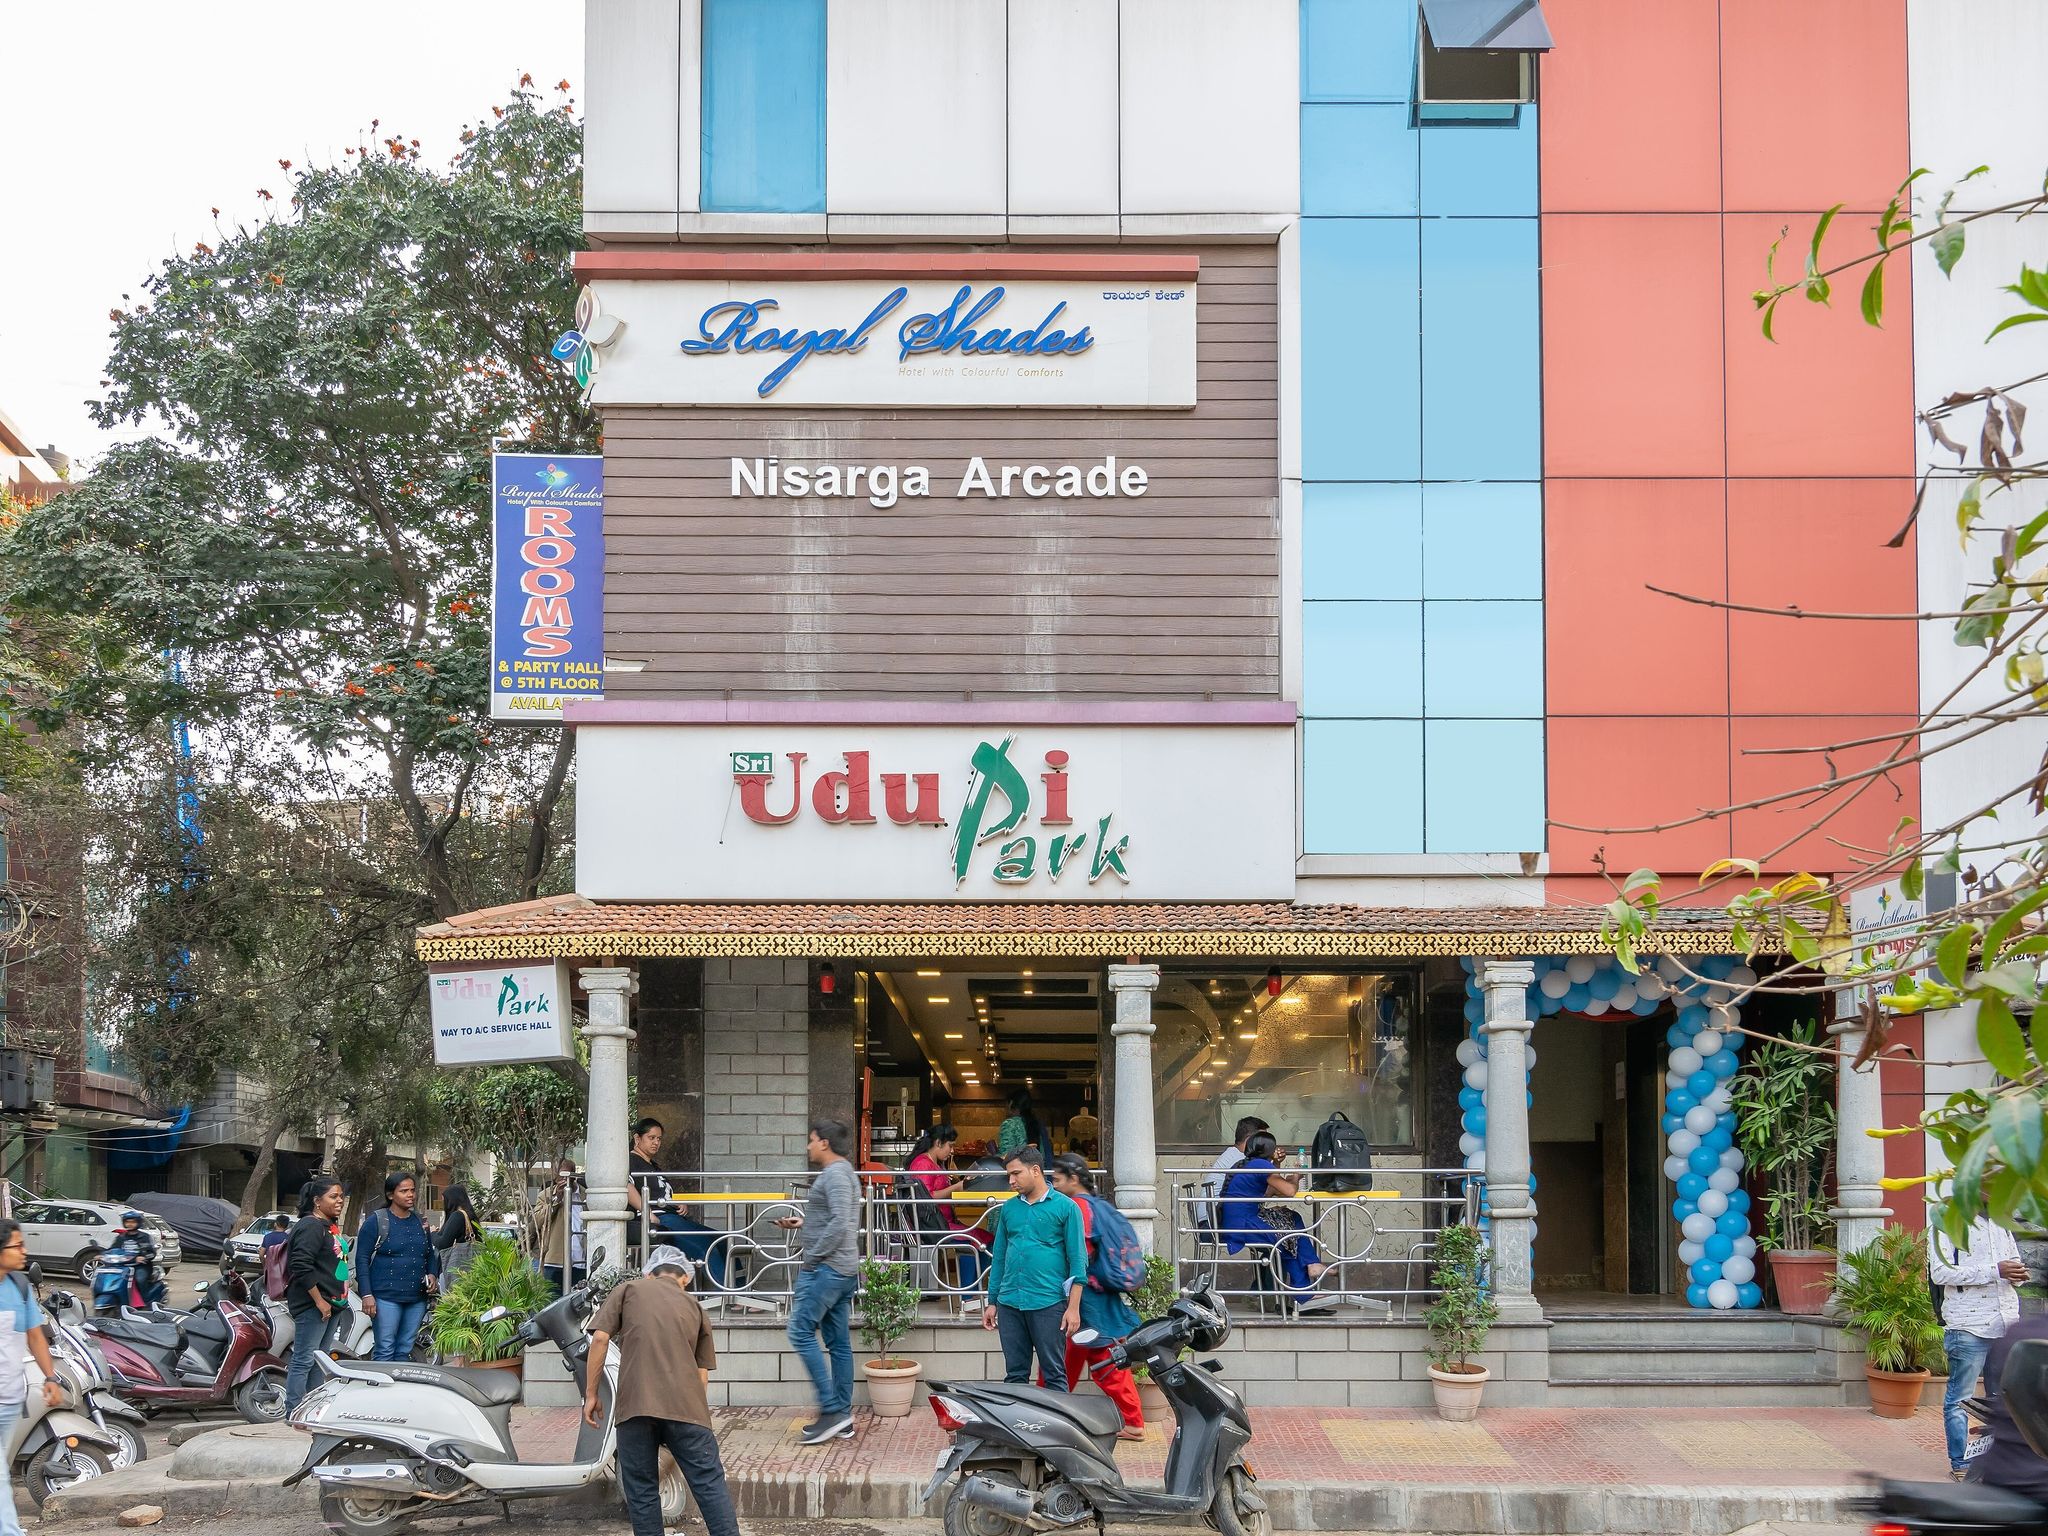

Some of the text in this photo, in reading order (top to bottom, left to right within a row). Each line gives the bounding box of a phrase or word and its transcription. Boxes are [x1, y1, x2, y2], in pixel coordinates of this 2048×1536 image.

[680, 284, 1095, 398] Royal Shades
[899, 367, 1064, 377] Hotel with Colourful Comforts
[731, 455, 1149, 508] Nisarga Arcade
[500, 483, 604, 506] Royal Shades
[520, 507, 577, 658] ROOMS
[498, 661, 603, 675] & PARTY HALL
[501, 676, 600, 690] @ 5TH FLOOR
[734, 754, 771, 773] Sri
[950, 730, 1131, 892] Park
[497, 974, 550, 1017] Park
[441, 1021, 552, 1037] WAY TO A/C SERVICE HALL
